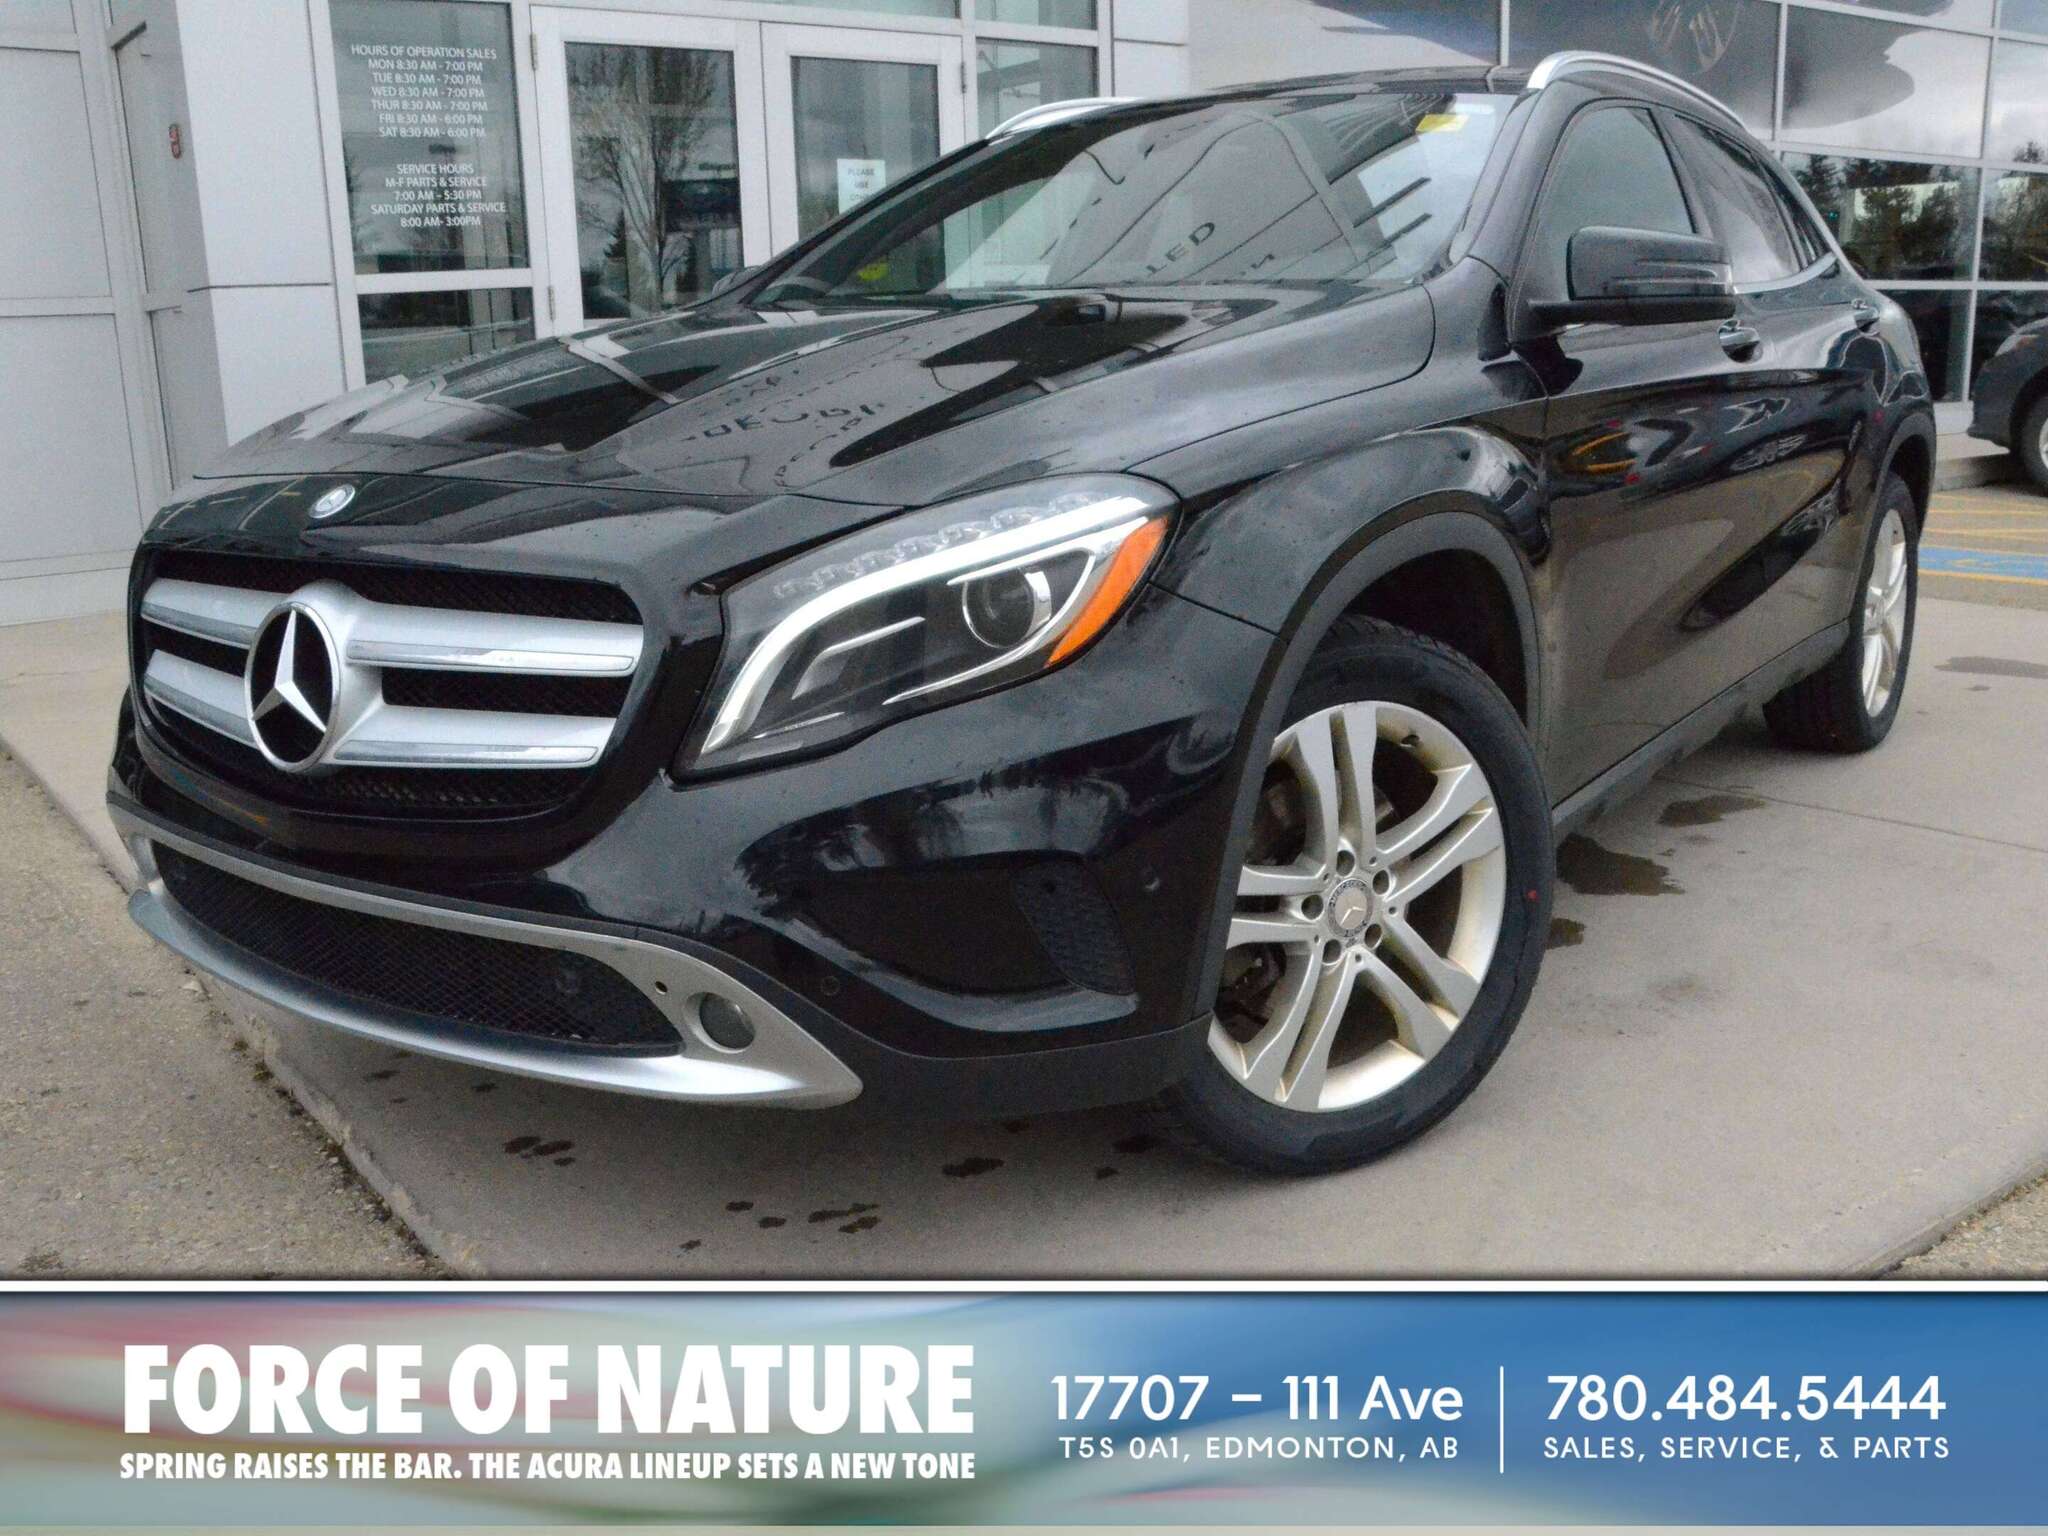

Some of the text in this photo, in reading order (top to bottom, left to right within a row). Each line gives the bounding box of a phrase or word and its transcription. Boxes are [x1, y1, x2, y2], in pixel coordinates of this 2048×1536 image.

[351, 44, 497, 60] HOURS OF OPERATION SALES
[368, 59, 395, 70] MON
[396, 59, 418, 70] 8:30
[419, 61, 438, 71] AM
[444, 61, 466, 72] 7:00
[467, 61, 484, 72] PM
[372, 72, 393, 83] TUE
[418, 74, 436, 84] AM
[443, 74, 464, 85] 7:00
[465, 74, 482, 85] PM
[371, 86, 397, 97] WED
[398, 87, 420, 97] 8:30
[422, 87, 439, 97] AM
[447, 87, 468, 98] 7:00
[469, 88, 486, 98] PM
[371, 99, 400, 110] THUR
[401, 100, 424, 110] 8:30
[425, 101, 442, 110] AM
[450, 101, 471, 111] 7:00
[472, 101, 489, 111] PM
[379, 113, 395, 124] FRI
[419, 114, 437, 124] AM
[467, 114, 484, 125] PM
[378, 127, 398, 137] SAT
[399, 127, 421, 137] 8:30
[422, 127, 440, 137] AM
[446, 127, 468, 137] 6:00
[469, 128, 487, 138] PM
[396, 163, 474, 175] SERVICE HOURS
[385, 176, 488, 188] M-F PARTS & SERVICE
[394, 191, 415, 201] 7:00
[417, 190, 434, 200] AM
[443, 190, 465, 200] 5:30
[466, 190, 482, 200] PM
[370, 202, 506, 215] SATURDAY PARTS & SERVICE
[400, 217, 422, 228] 8:00
